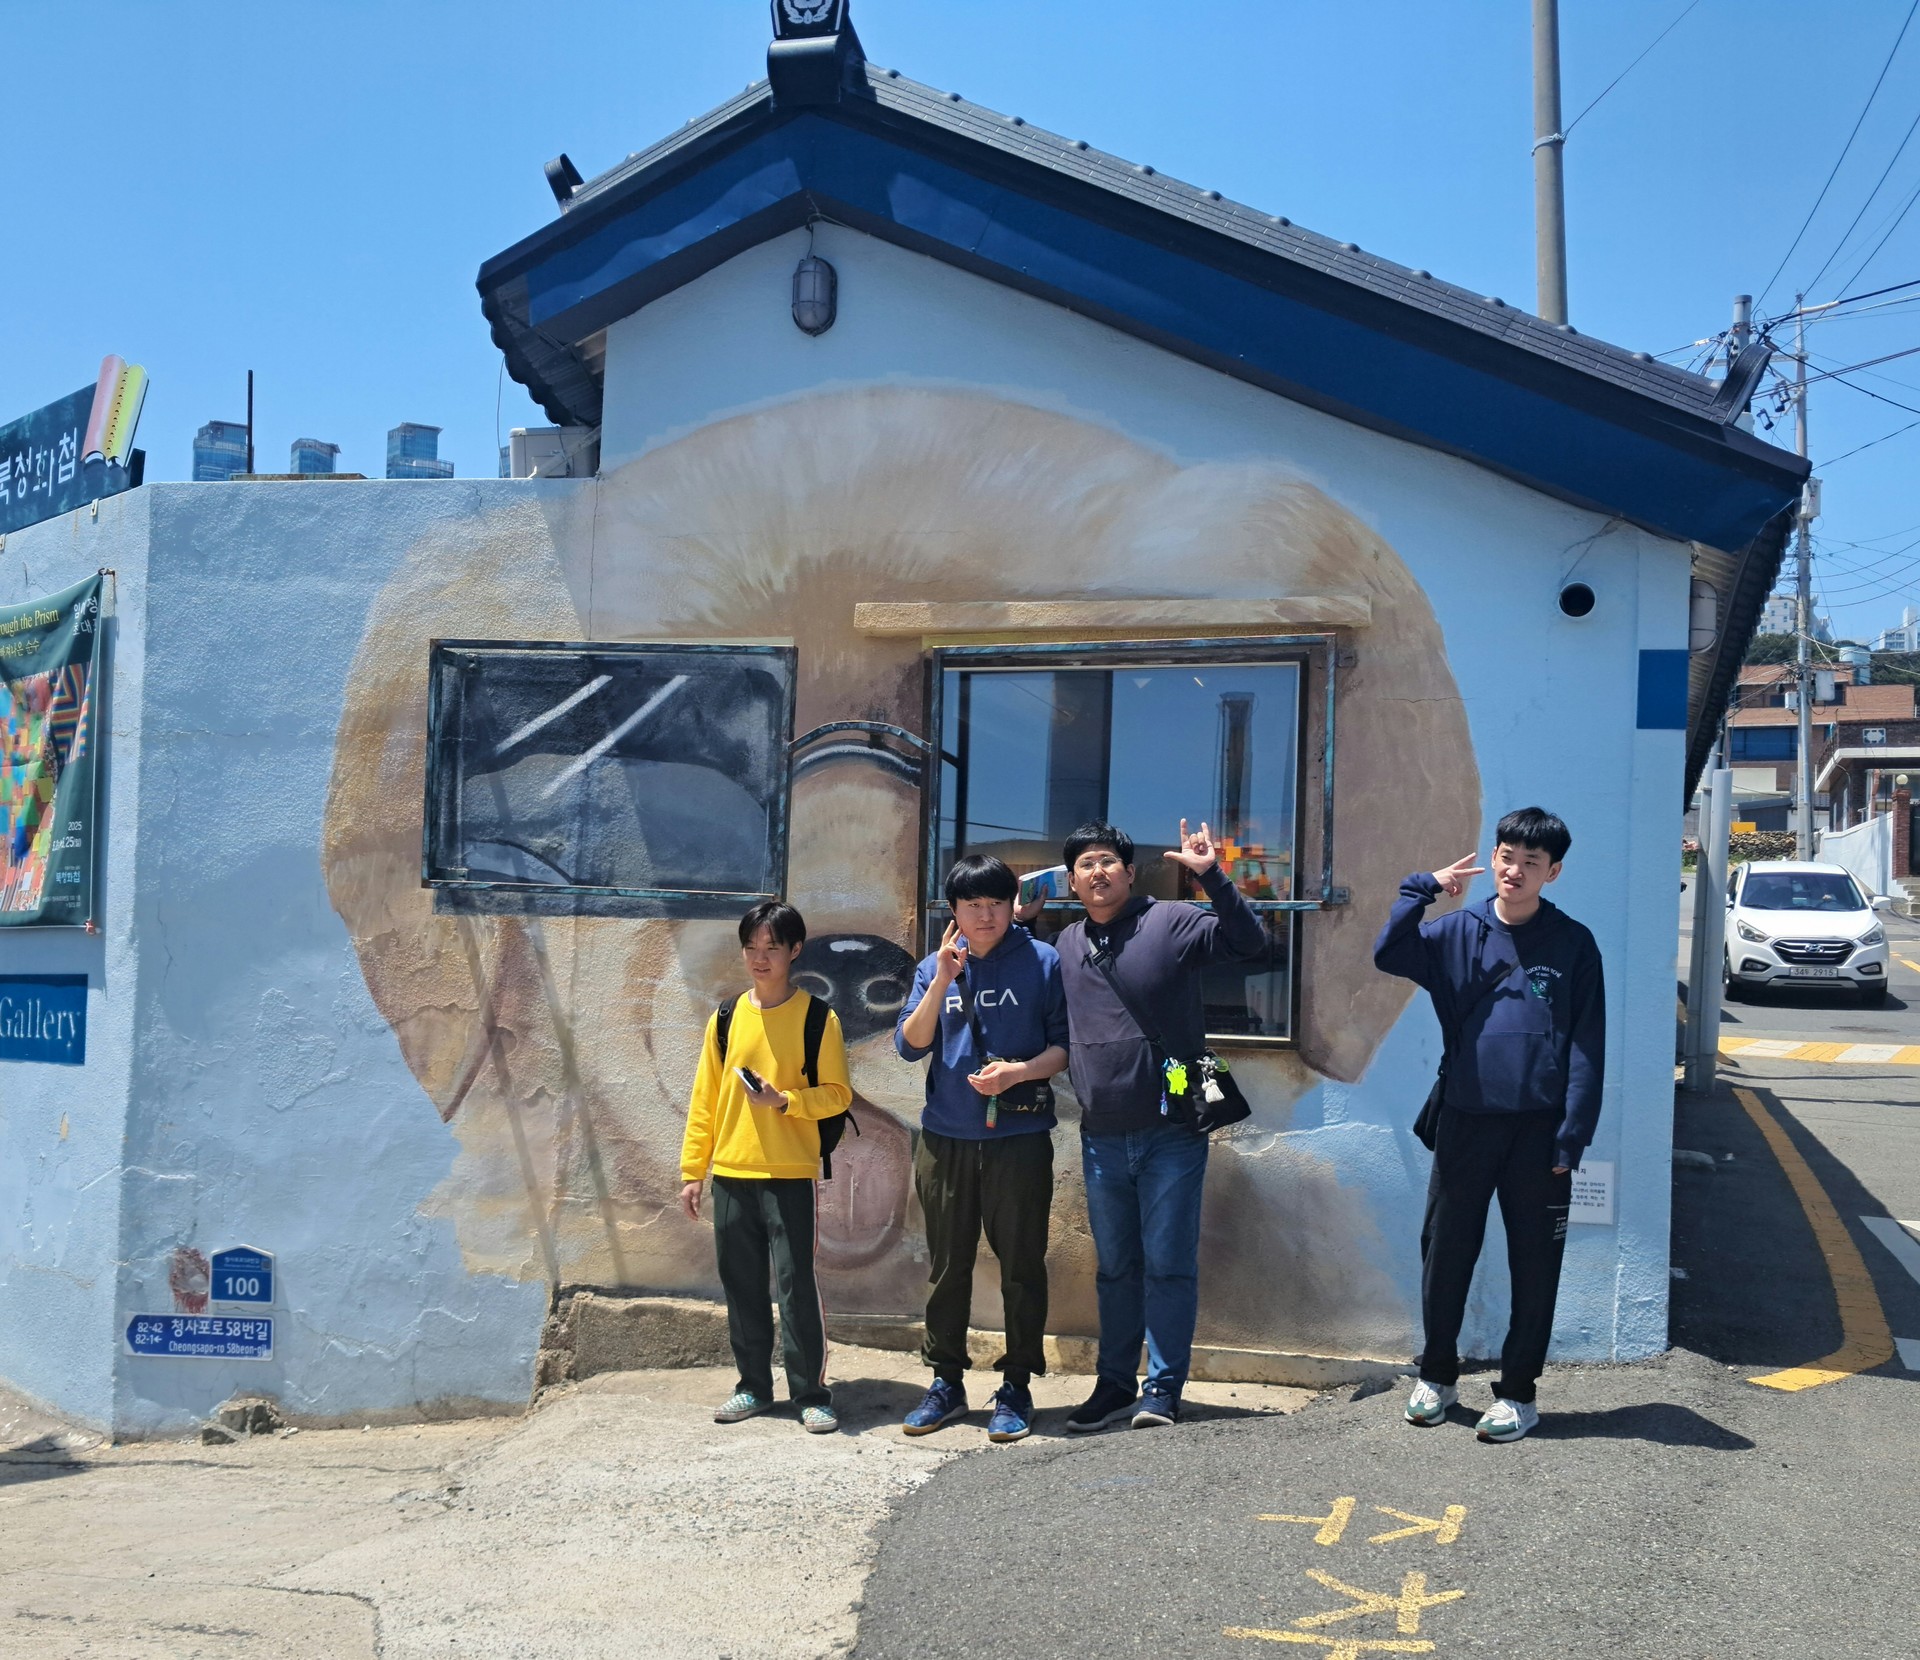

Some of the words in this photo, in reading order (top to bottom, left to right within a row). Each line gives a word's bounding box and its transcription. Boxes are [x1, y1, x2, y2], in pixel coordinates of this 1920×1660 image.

[20, 613, 32, 630] the
[34, 607, 60, 626] Prism
[25, 637, 40, 654] 순수
[68, 821, 82, 831] 2025
[0, 996, 81, 1048] Gallery
[224, 1277, 260, 1297] 100
[137, 1322, 164, 1334] 82-42
[135, 1334, 154, 1345] 82-1
[168, 1341, 225, 1355] Cheongsapo-ro
[226, 1342, 268, 1358] 58beon-gil
